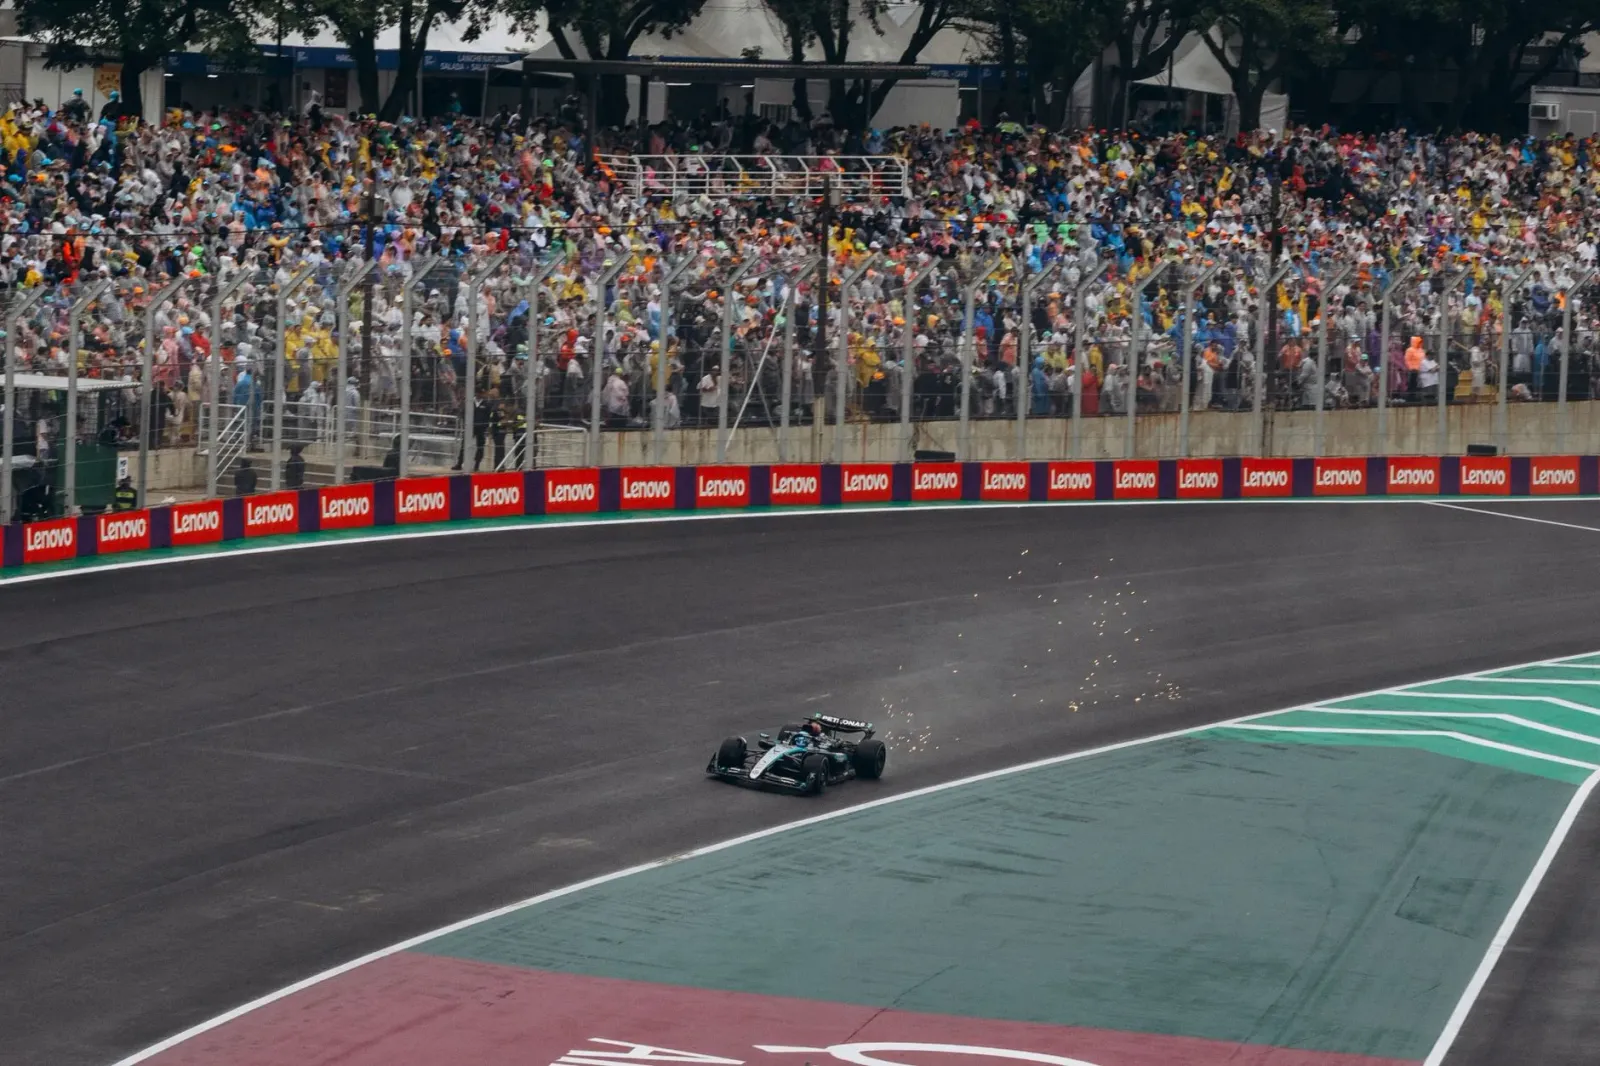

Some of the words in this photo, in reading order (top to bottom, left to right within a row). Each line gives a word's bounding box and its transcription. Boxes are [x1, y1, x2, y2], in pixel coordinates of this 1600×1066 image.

[773, 473, 816, 493] Lenovo
[844, 472, 888, 491] Lenovo
[915, 470, 957, 489] Lenovo
[984, 470, 1025, 489] Lenovo
[1051, 470, 1091, 489] Lenovo
[1116, 469, 1155, 488] Lenovo
[1180, 469, 1218, 488] Lenovo
[1244, 468, 1287, 486] Lenovo
[1316, 467, 1361, 485] Lenovo
[1390, 466, 1434, 484] Lenovo
[1462, 466, 1505, 485] Lenovo
[1533, 467, 1575, 485] Lenovo
[549, 481, 594, 502] Lenovo
[624, 478, 670, 498] Lenovo
[700, 476, 745, 496] Lenovo
[399, 491, 445, 512] Lenovo
[474, 486, 519, 507] Lenovo
[248, 503, 293, 525] Lenovo
[322, 496, 369, 518] Lenovo
[101, 519, 146, 541] Lenovo
[174, 511, 219, 533] Lenovo
[27, 528, 72, 550] Lenovo
